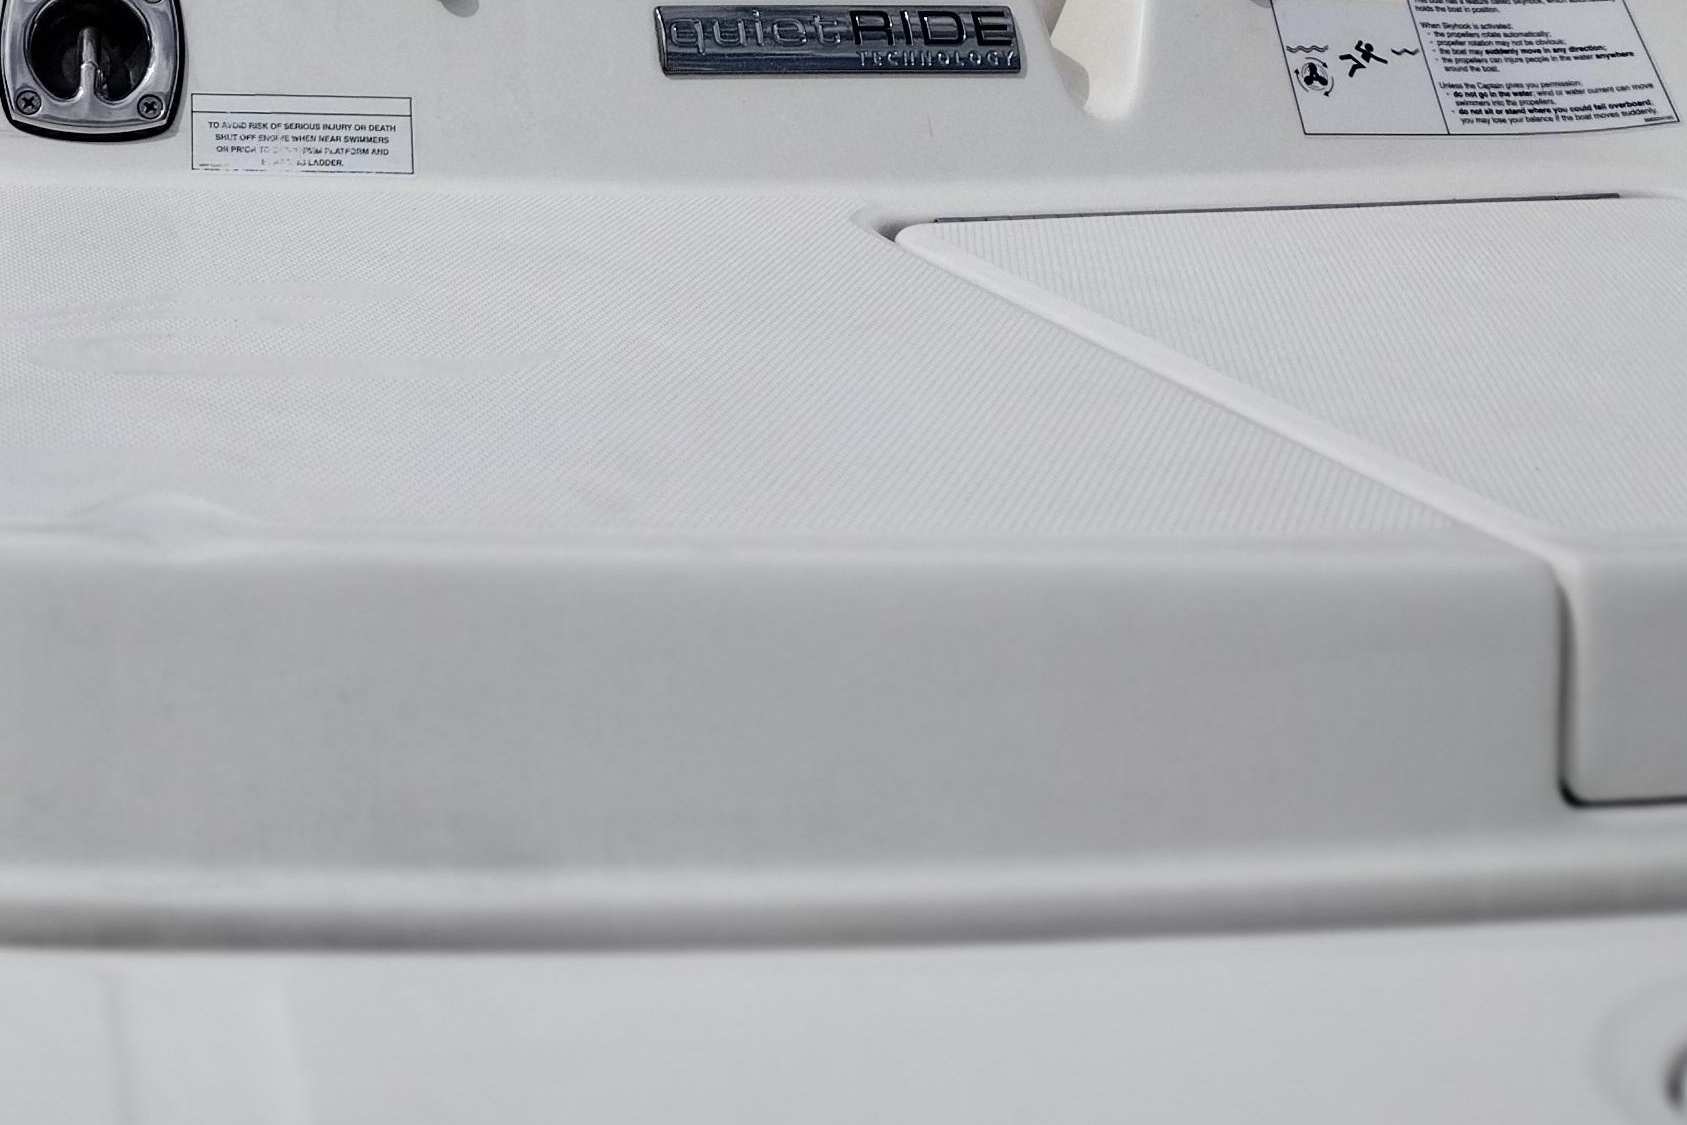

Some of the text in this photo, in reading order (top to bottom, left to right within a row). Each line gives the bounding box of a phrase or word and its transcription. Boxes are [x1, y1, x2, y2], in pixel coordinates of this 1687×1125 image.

[1485, 48, 1519, 56] suddenly
[857, 49, 1015, 67] TECHNOLOGY
[1470, 107, 1483, 115] not
[1484, 107, 1494, 115] sit
[1504, 106, 1526, 115] stand
[1527, 106, 1552, 114] where
[1552, 106, 1568, 114] you
[1570, 104, 1593, 112] could
[208, 121, 220, 129] TO
[249, 122, 268, 130] RISK
[271, 122, 282, 130] OF
[322, 123, 353, 131] INJURY
[369, 124, 397, 132] DEATH
[319, 135, 341, 143] NEAR
[344, 135, 390, 144] SWIMMERS
[216, 145, 229, 153] OR
[372, 148, 389, 156] AND
